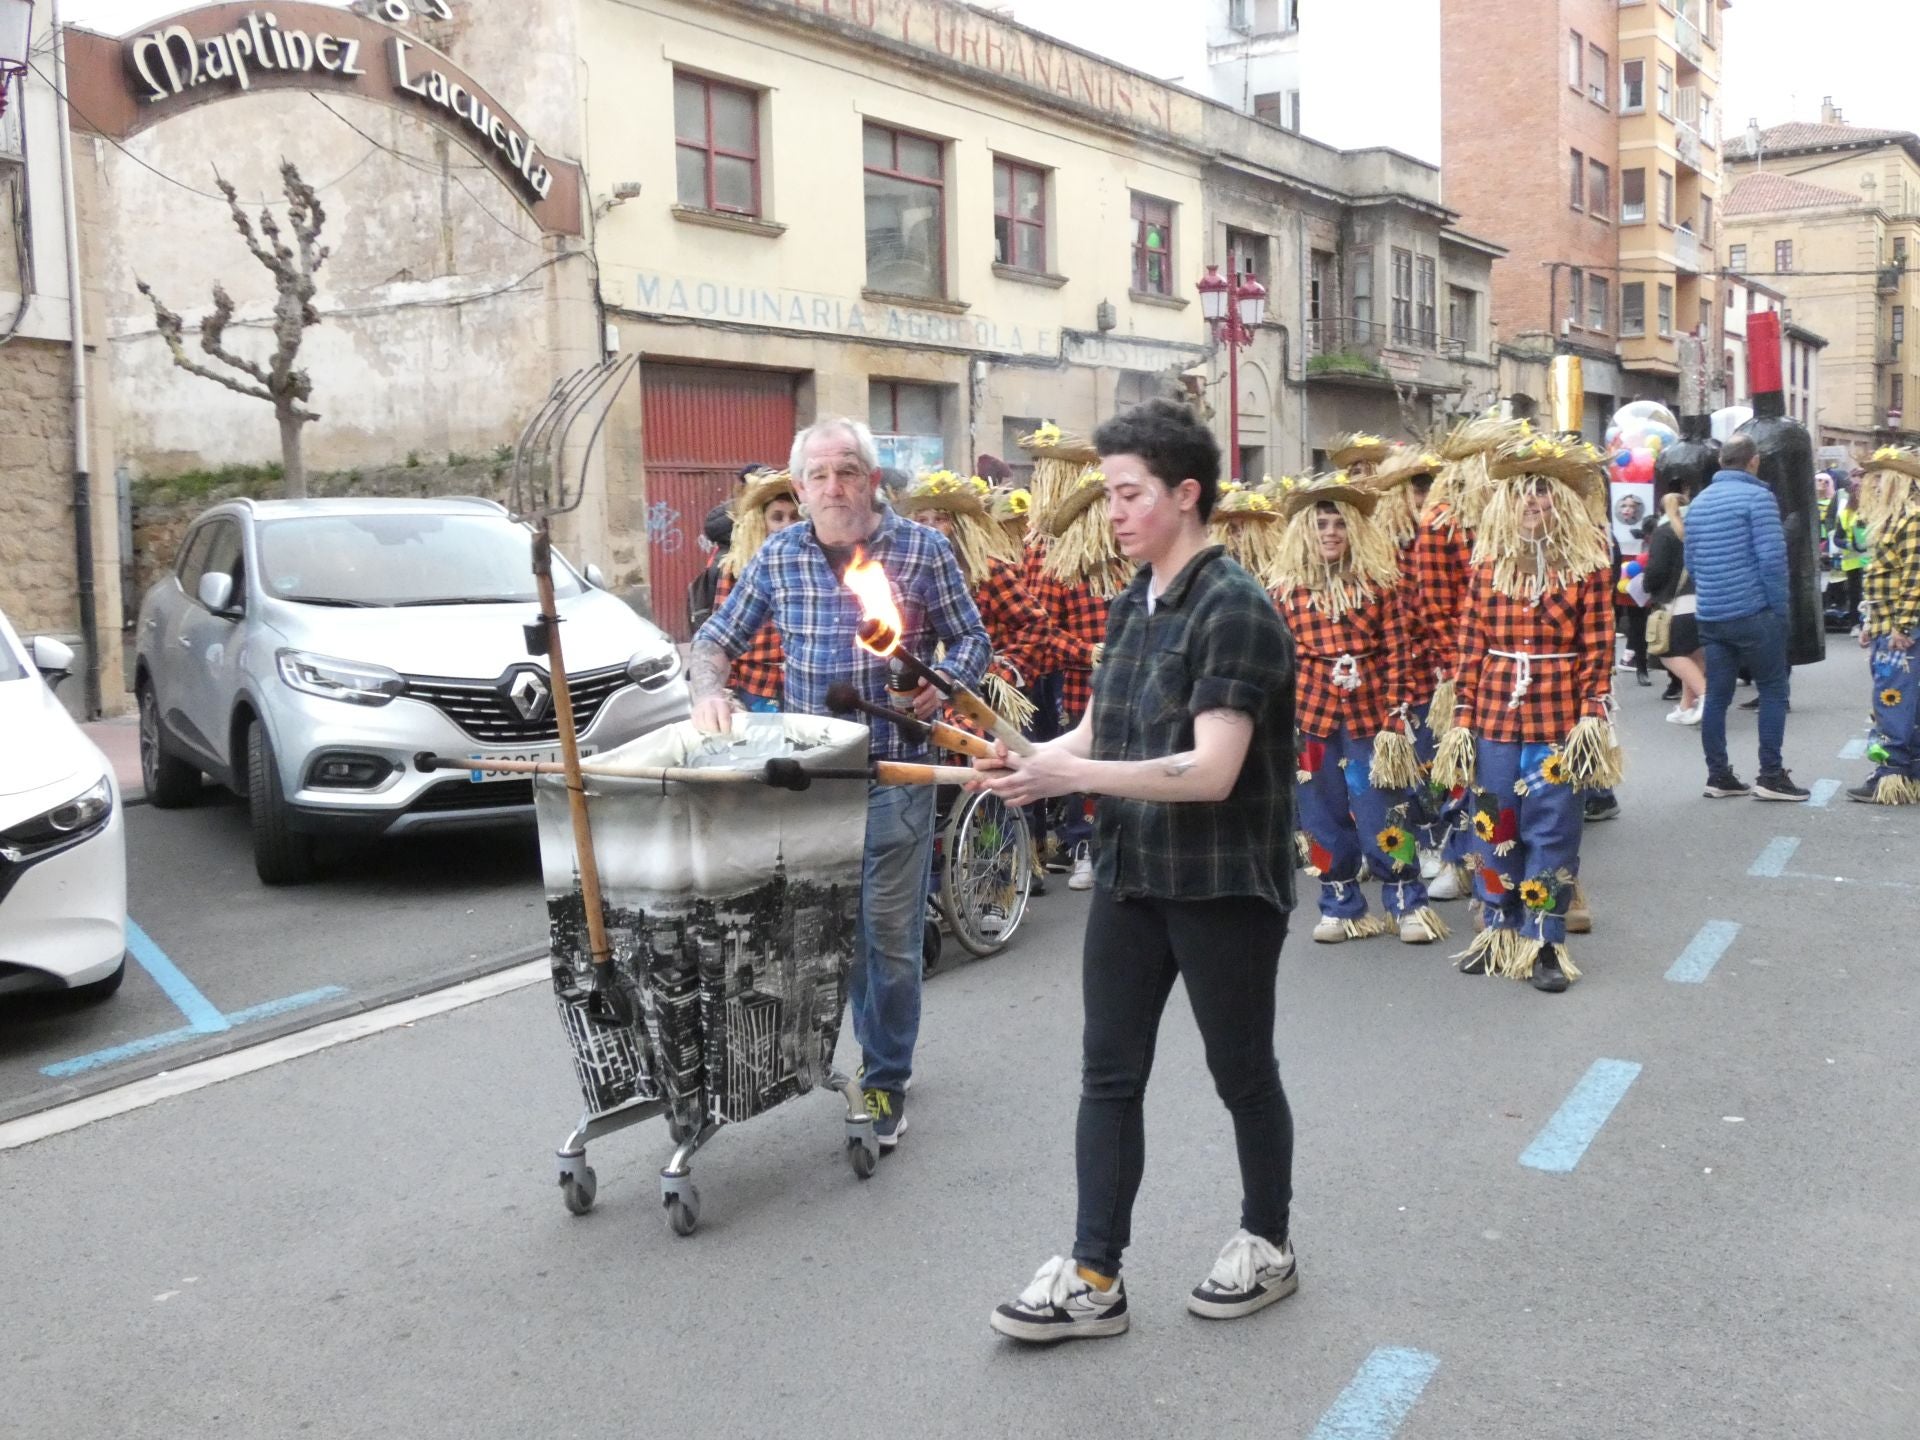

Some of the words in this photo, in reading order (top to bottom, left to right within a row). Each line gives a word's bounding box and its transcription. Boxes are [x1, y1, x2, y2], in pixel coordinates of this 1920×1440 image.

[132, 10, 367, 103] Martinez
[395, 37, 553, 200] Lacuesta
[637, 272, 868, 335] MAQUINARIA
